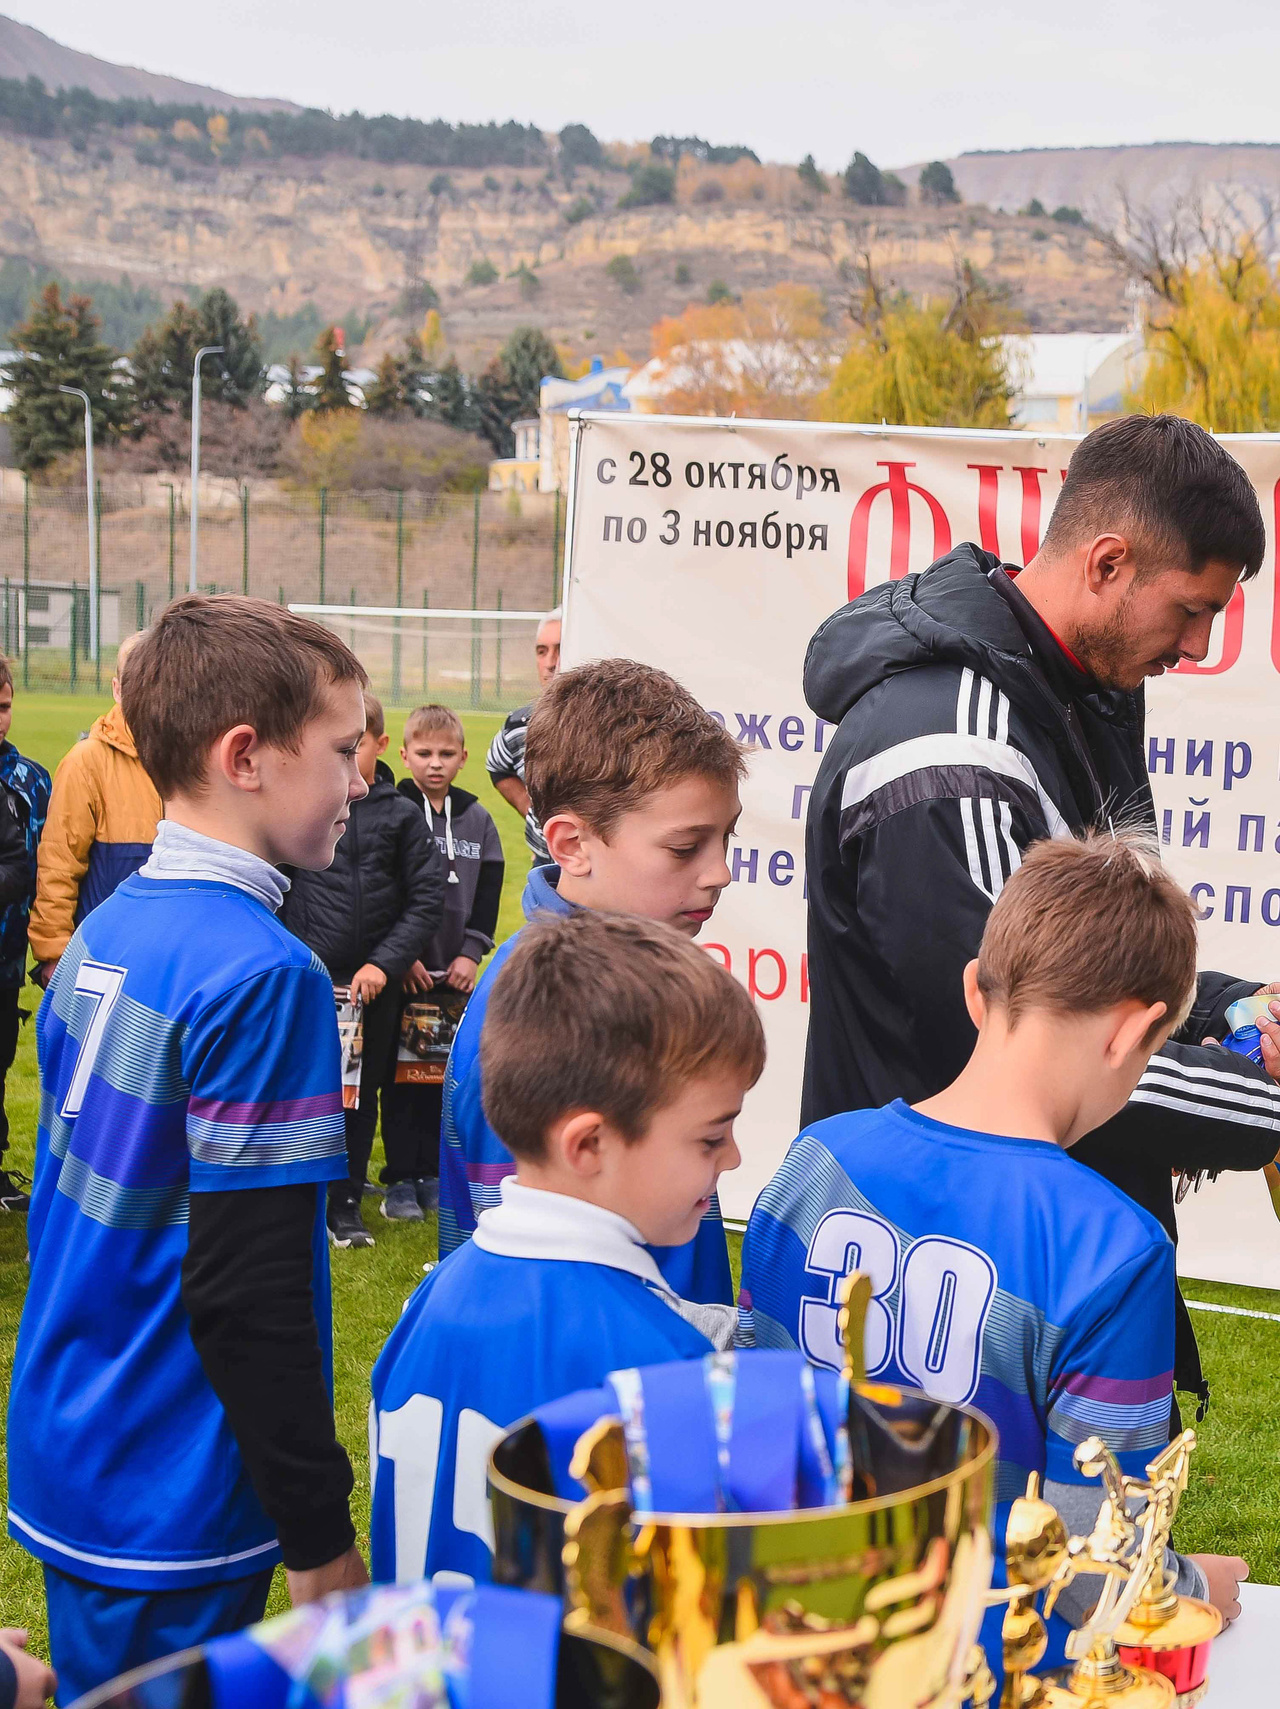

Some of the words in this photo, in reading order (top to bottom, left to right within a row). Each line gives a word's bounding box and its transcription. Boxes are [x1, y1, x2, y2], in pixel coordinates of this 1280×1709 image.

[596, 457, 617, 485] с
[628, 450, 672, 488] 28
[684, 453, 841, 500] октября
[602, 515, 647, 544] по
[658, 509, 681, 546] 3
[692, 511, 829, 559] ноября
[1148, 737, 1252, 791] нир
[59, 959, 129, 1118] 7
[799, 1207, 998, 1408] 30
